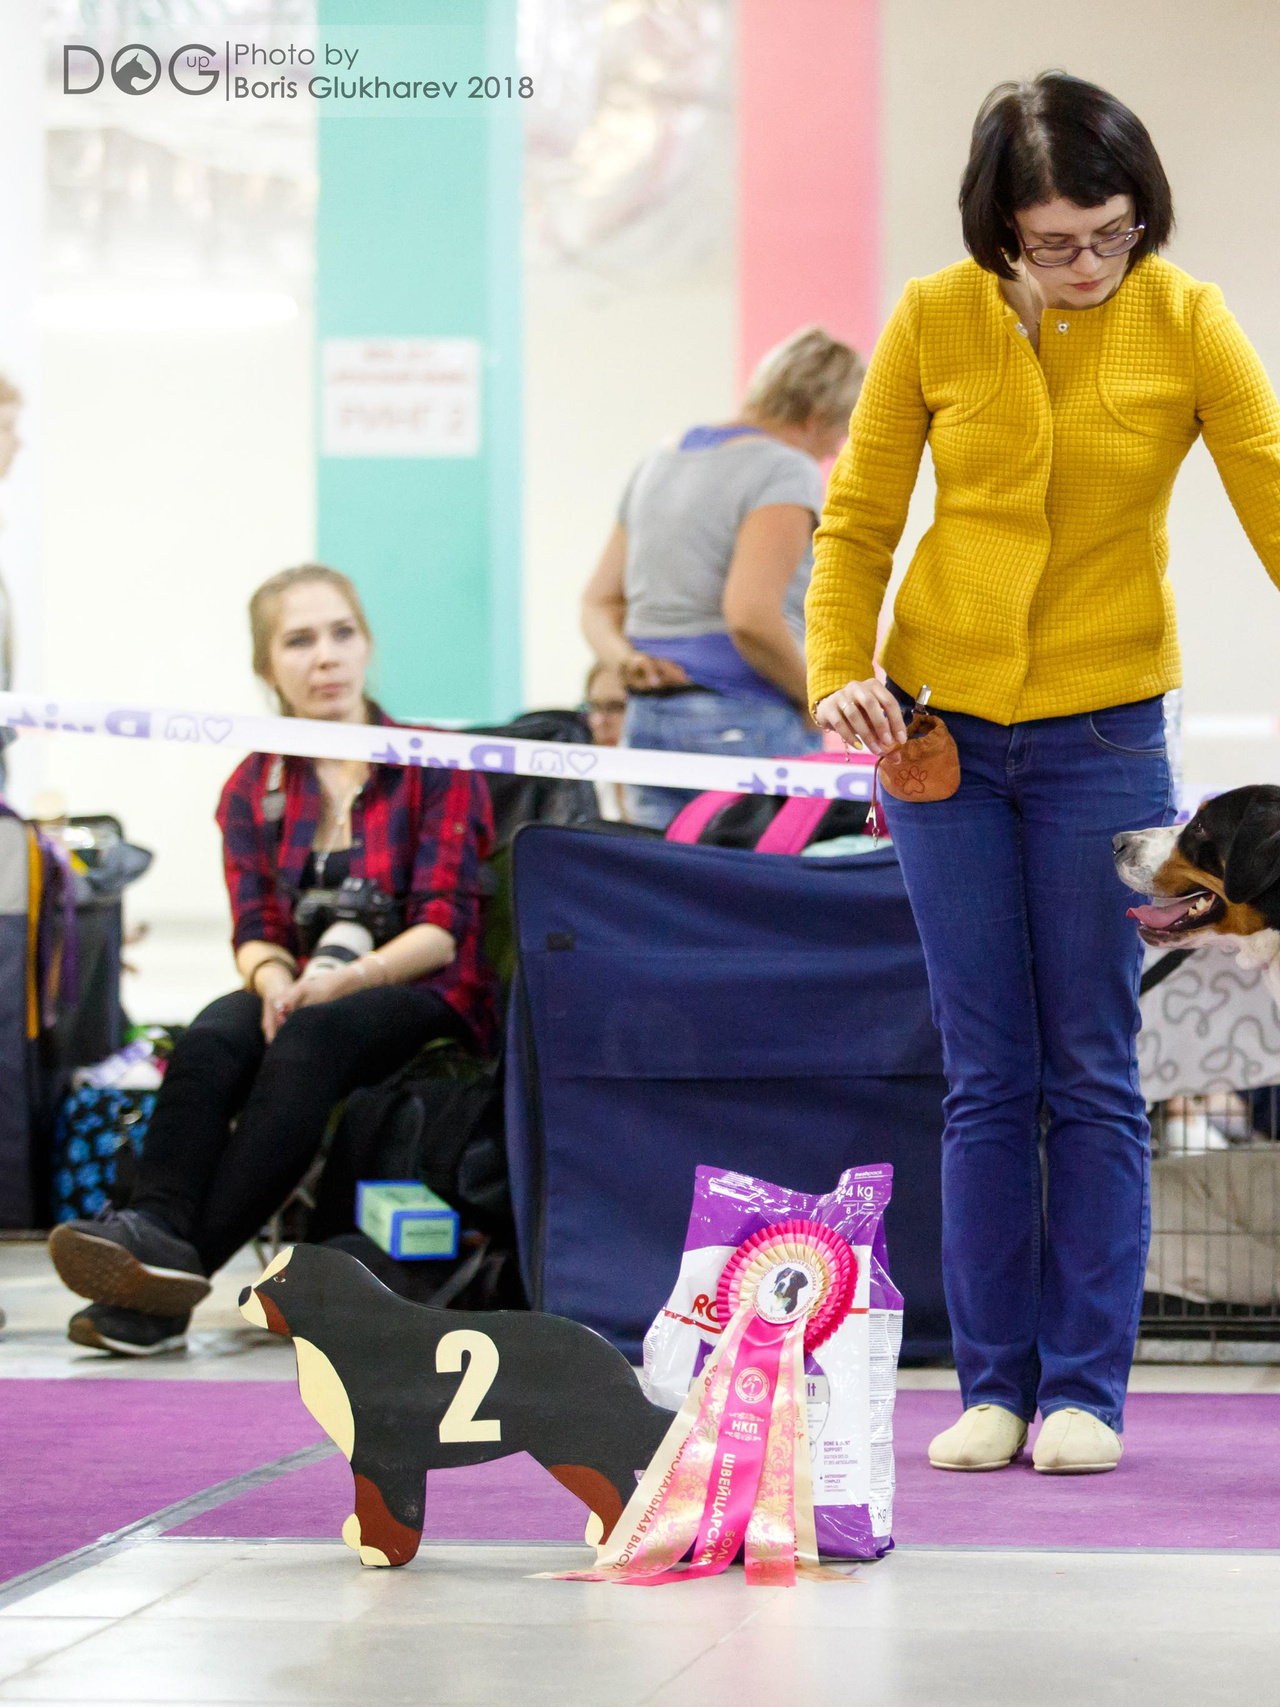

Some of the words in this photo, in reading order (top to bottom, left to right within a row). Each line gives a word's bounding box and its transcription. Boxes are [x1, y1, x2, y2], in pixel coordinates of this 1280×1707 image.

[845, 1184, 854, 1198] 4
[857, 1184, 874, 1201] kg
[435, 1329, 501, 1443] 2
[732, 1420, 758, 1435] НКП
[637, 1427, 693, 1532] ЦОНАЛЬНАЯ
[698, 1453, 736, 1566] ШВЕЙЦАРСКИЙ
